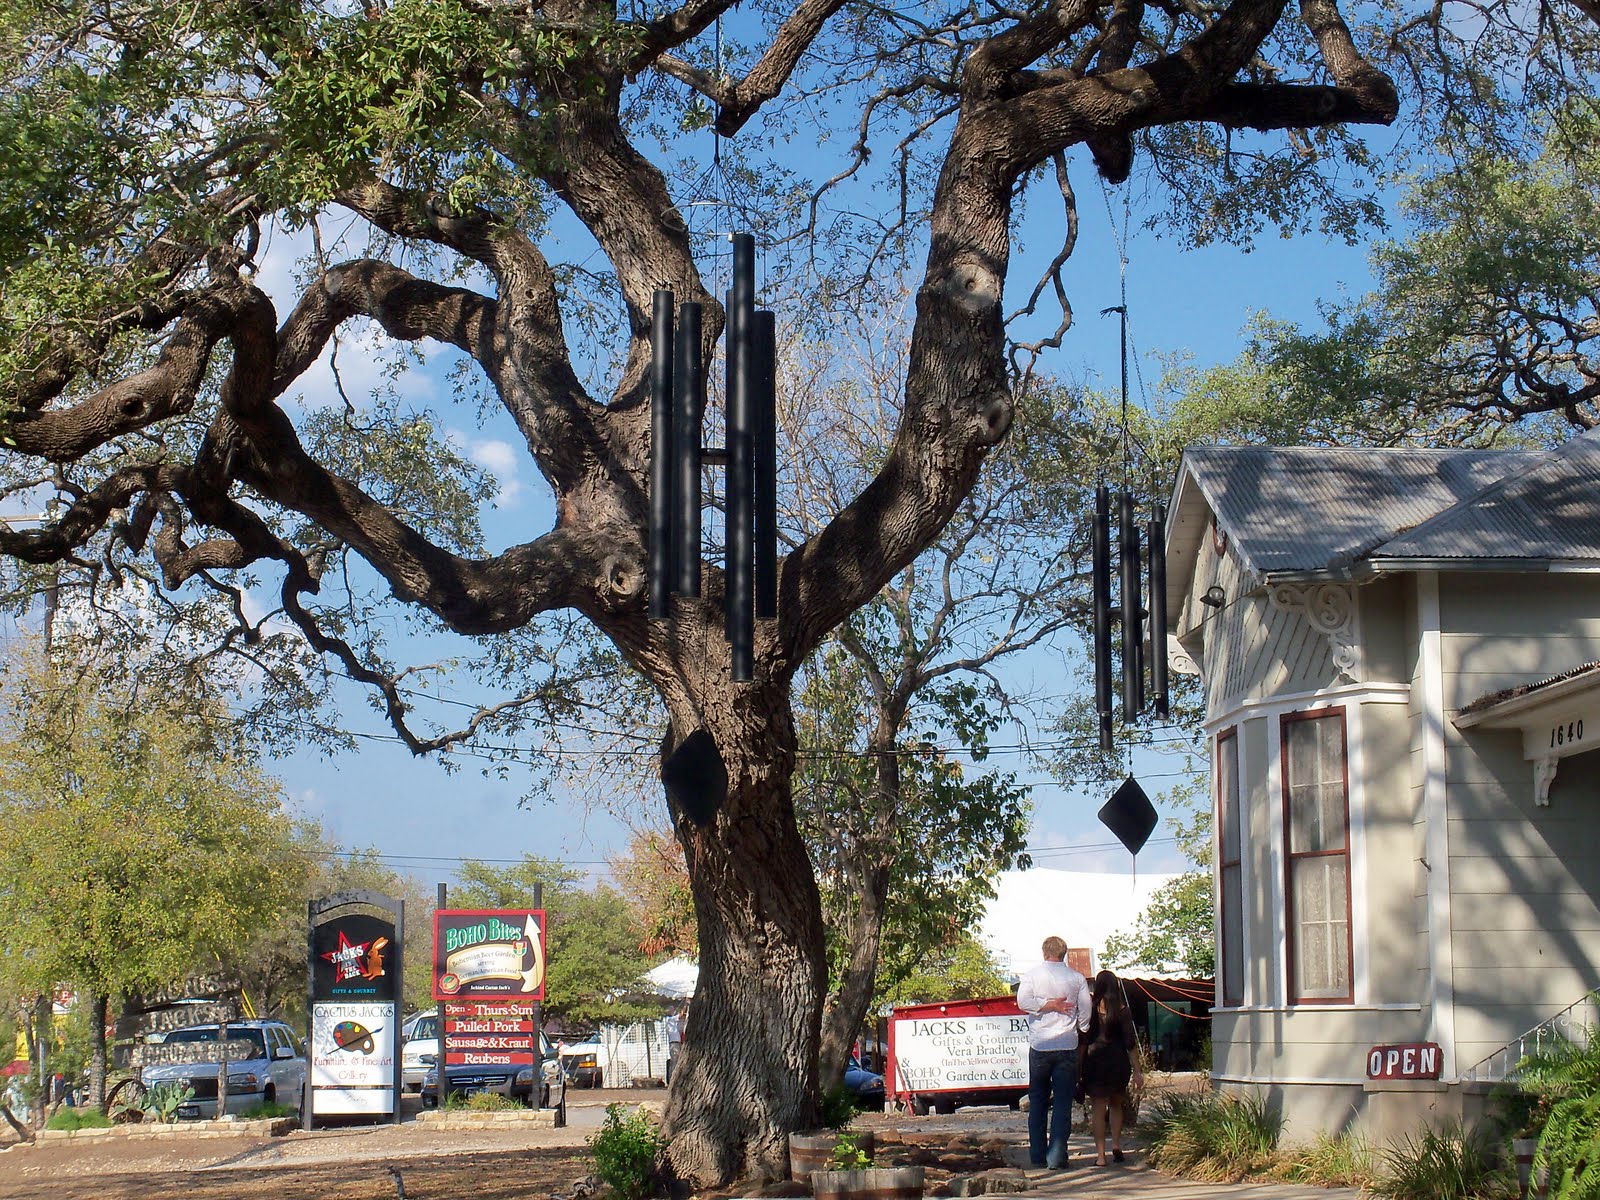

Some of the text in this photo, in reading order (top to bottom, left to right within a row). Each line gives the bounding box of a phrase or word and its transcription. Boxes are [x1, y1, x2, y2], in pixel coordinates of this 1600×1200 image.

[1551, 719, 1583, 748] 1640
[446, 918, 522, 952] BOHO Bites
[331, 945, 364, 964] JACKS
[314, 1006, 394, 1018] CACTUS JACKS
[445, 1005, 466, 1014] Open
[455, 1021, 521, 1032] Pulled Pork
[912, 1020, 967, 1037] JACKS
[975, 1023, 984, 1031] In
[986, 1022, 1001, 1031] The
[932, 1034, 1030, 1047] Gifts & Gourmet
[947, 1044, 1018, 1057] Vera Bradley
[380, 1057, 393, 1066] Art
[464, 1053, 511, 1064] Reubens
[901, 1057, 910, 1068] &
[967, 1057, 989, 1066] Yellow
[1370, 1047, 1436, 1076] OPEN
[946, 1068, 1026, 1082] Garden & Cafe
[909, 1078, 941, 1090] ITES
